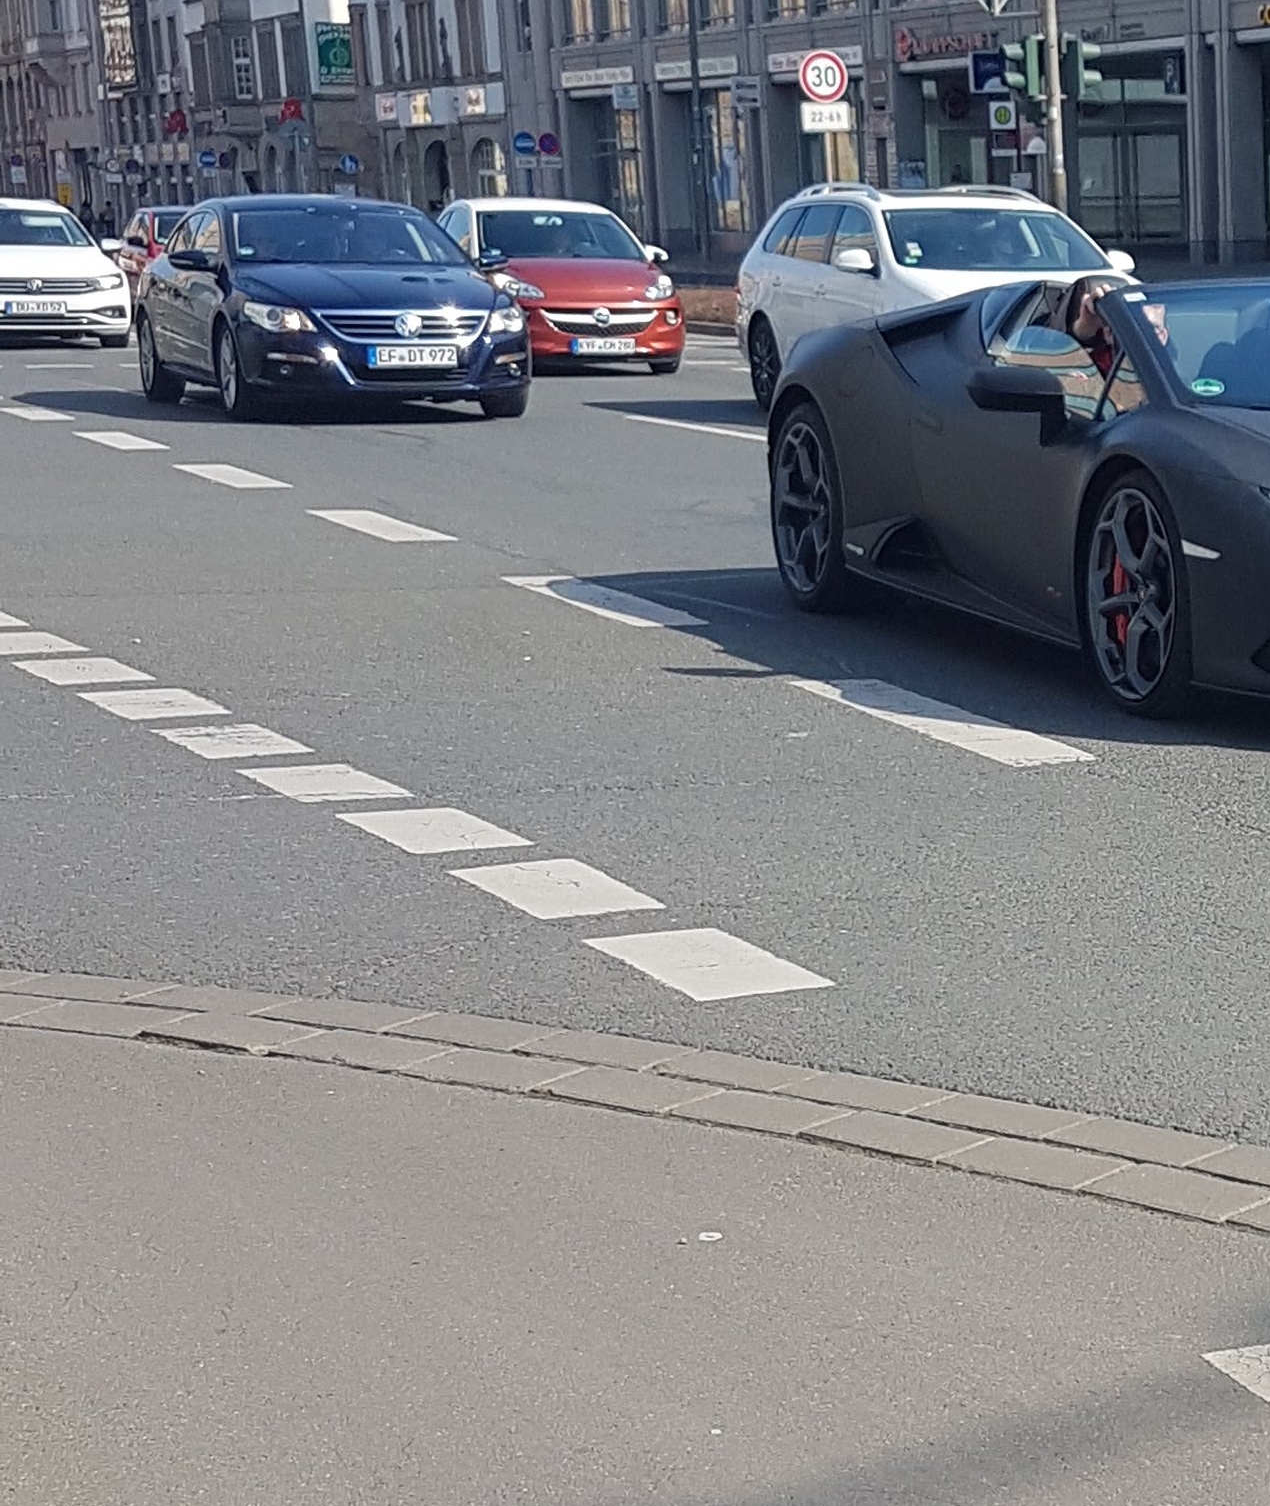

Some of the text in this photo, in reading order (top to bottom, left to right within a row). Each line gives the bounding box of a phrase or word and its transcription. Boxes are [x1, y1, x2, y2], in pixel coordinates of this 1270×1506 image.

[811, 65, 837, 88] 30
[379, 348, 456, 362] EF DT 972
